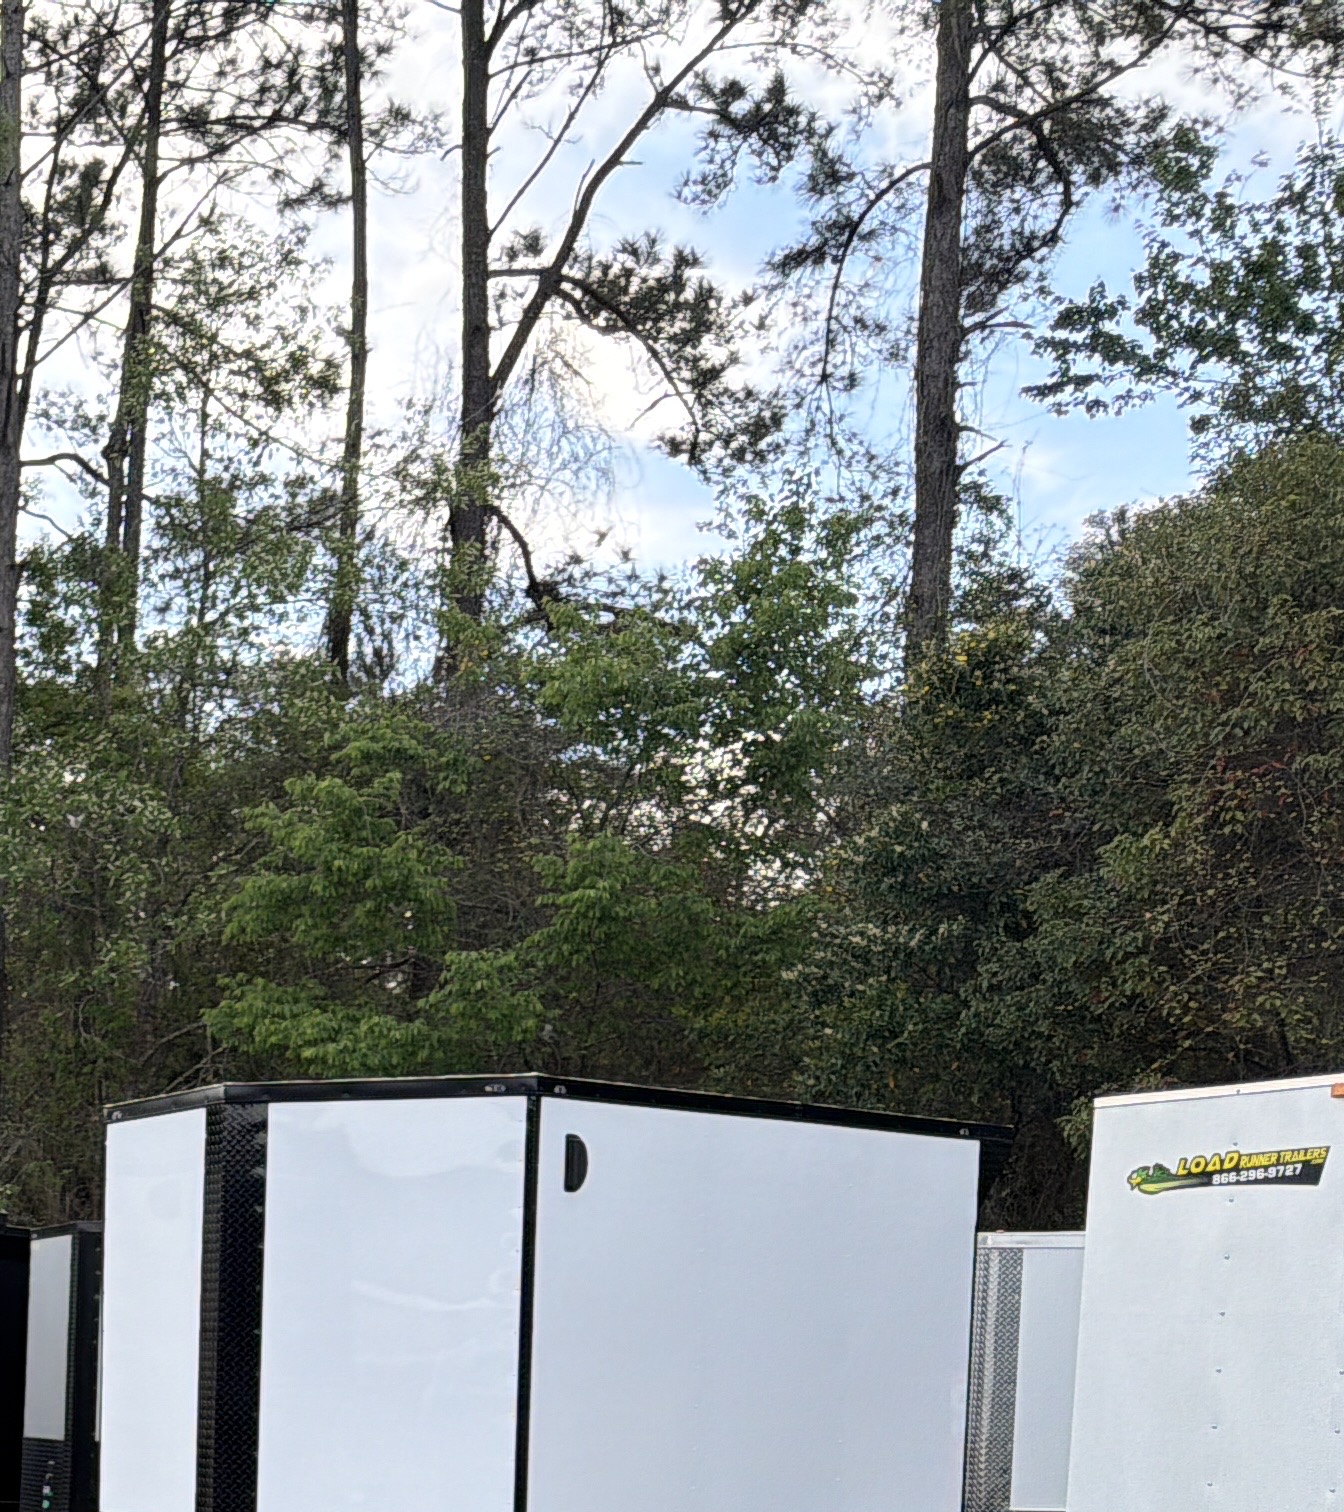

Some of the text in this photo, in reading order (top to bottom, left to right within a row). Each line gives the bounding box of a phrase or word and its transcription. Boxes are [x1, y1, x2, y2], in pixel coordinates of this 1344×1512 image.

[1177, 1152, 1240, 1176] LOAD
[1239, 1153, 1278, 1169] RUNNER
[1279, 1148, 1327, 1164] TRAILERS
[1212, 1163, 1302, 1185] 866-296-9727
